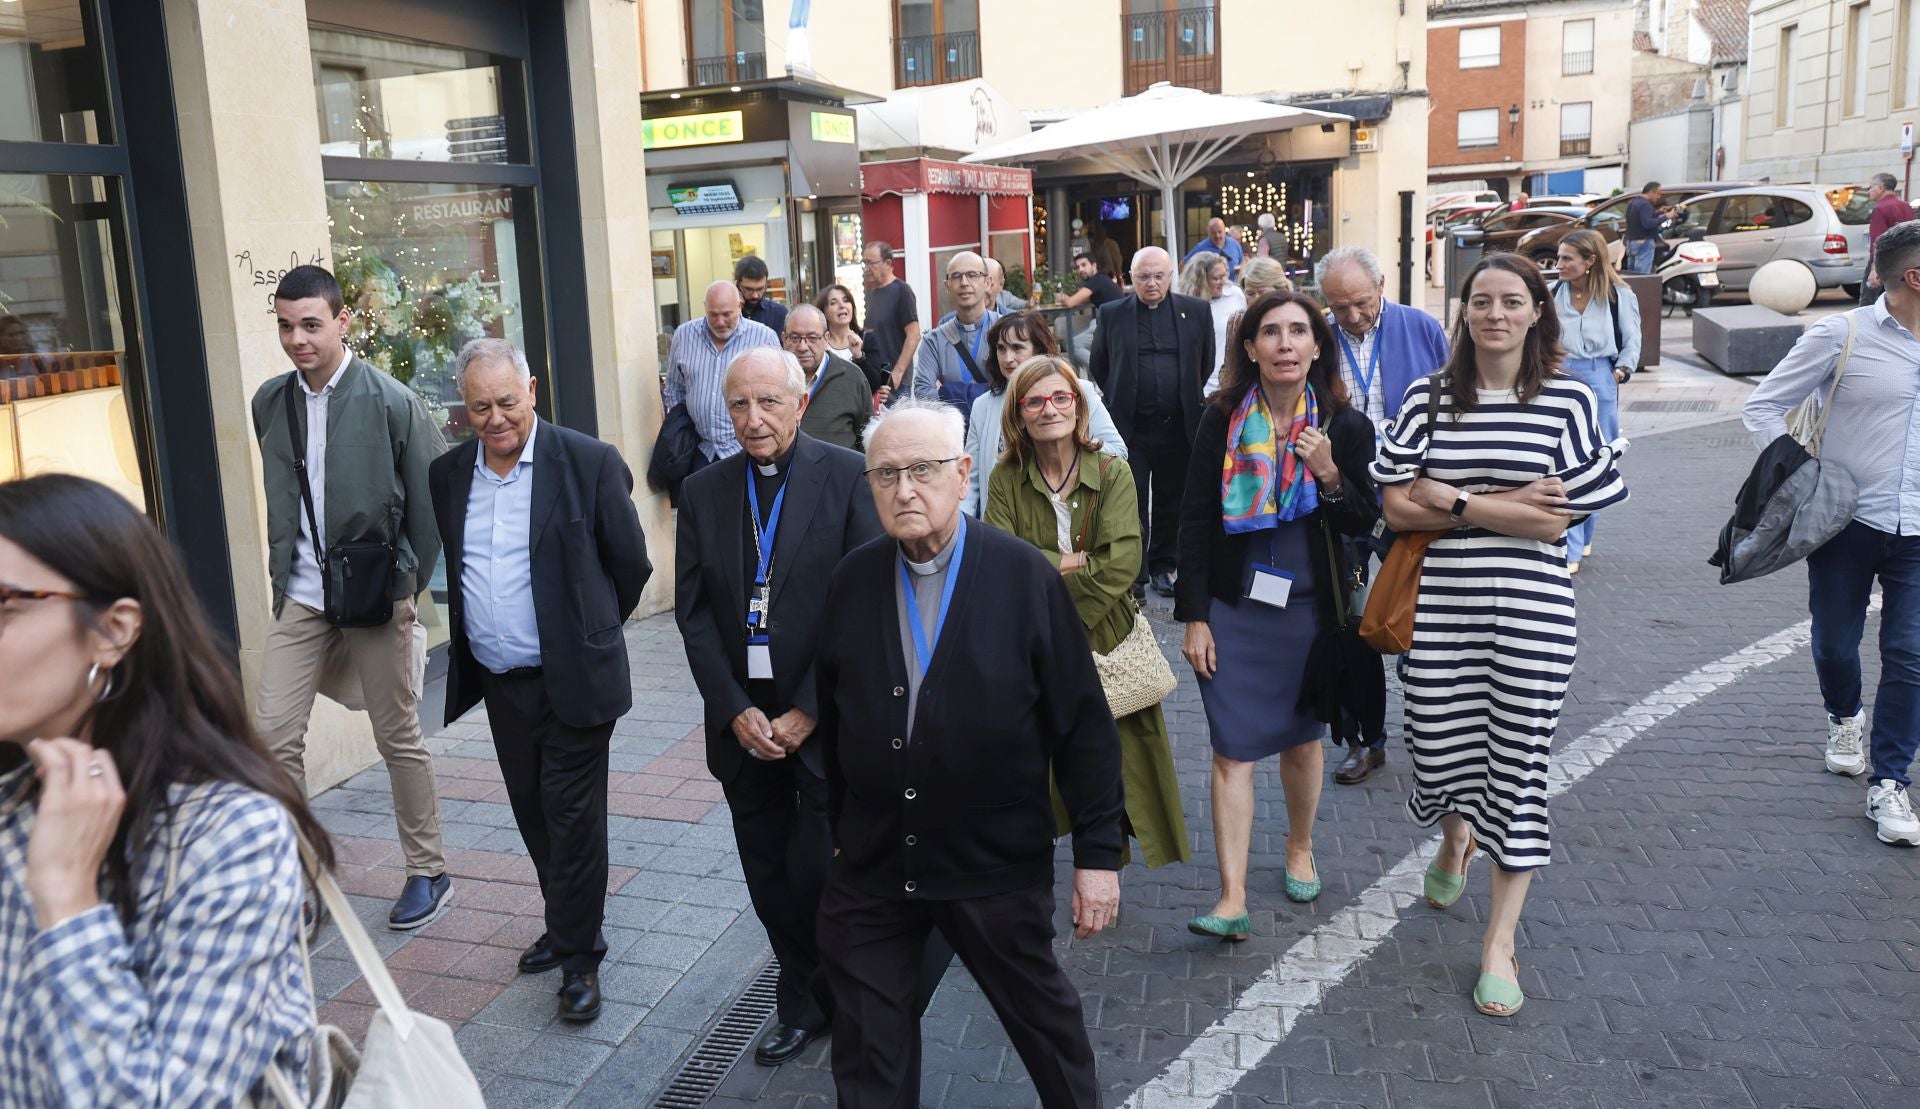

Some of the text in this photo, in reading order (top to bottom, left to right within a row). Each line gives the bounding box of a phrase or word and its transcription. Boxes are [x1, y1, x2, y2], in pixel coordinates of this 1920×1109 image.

[663, 118, 732, 140] ONCE
[824, 120, 850, 137] ONCE
[413, 197, 512, 221] RESTAURAN
[1222, 182, 1286, 214] DON
